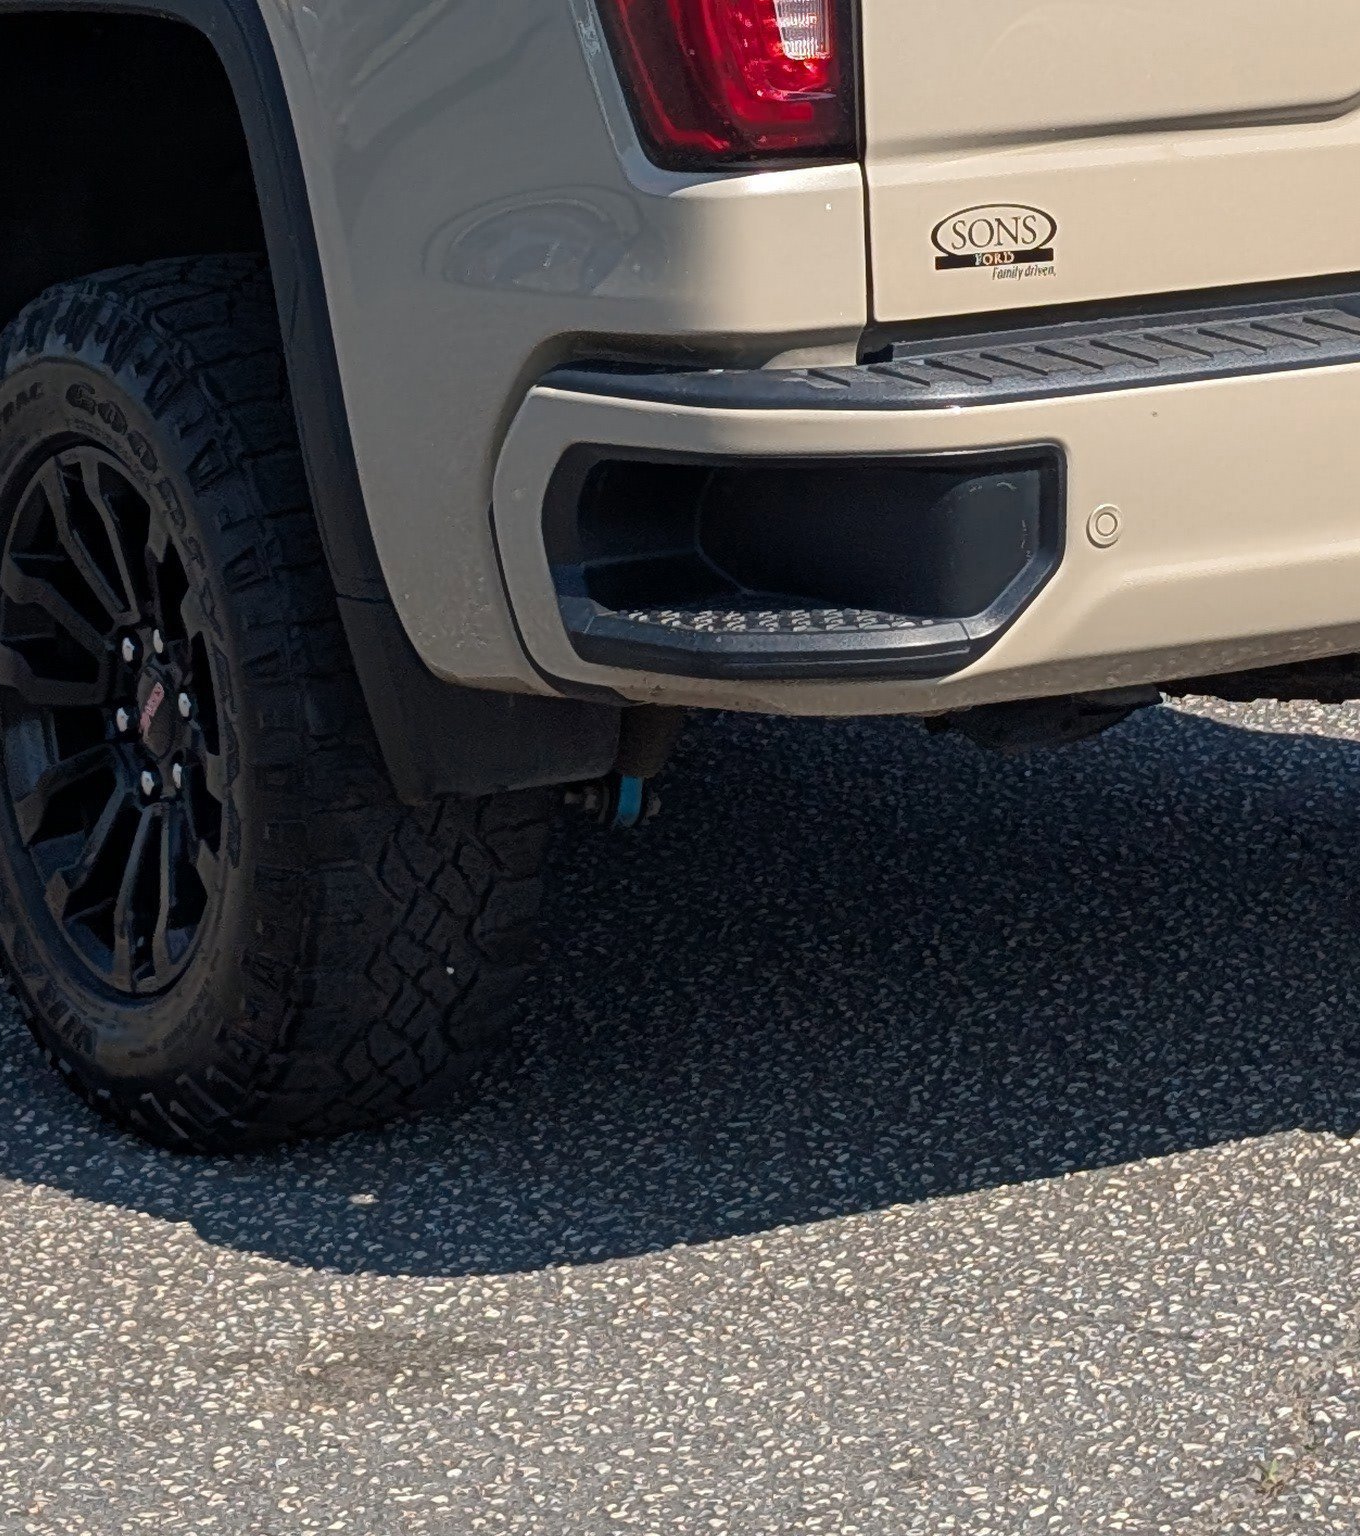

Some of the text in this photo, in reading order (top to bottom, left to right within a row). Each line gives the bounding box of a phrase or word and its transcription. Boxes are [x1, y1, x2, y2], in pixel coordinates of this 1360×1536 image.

[951, 215, 1037, 250] SONS
[974, 251, 1015, 265] FORD
[992, 266, 1023, 281] Family
